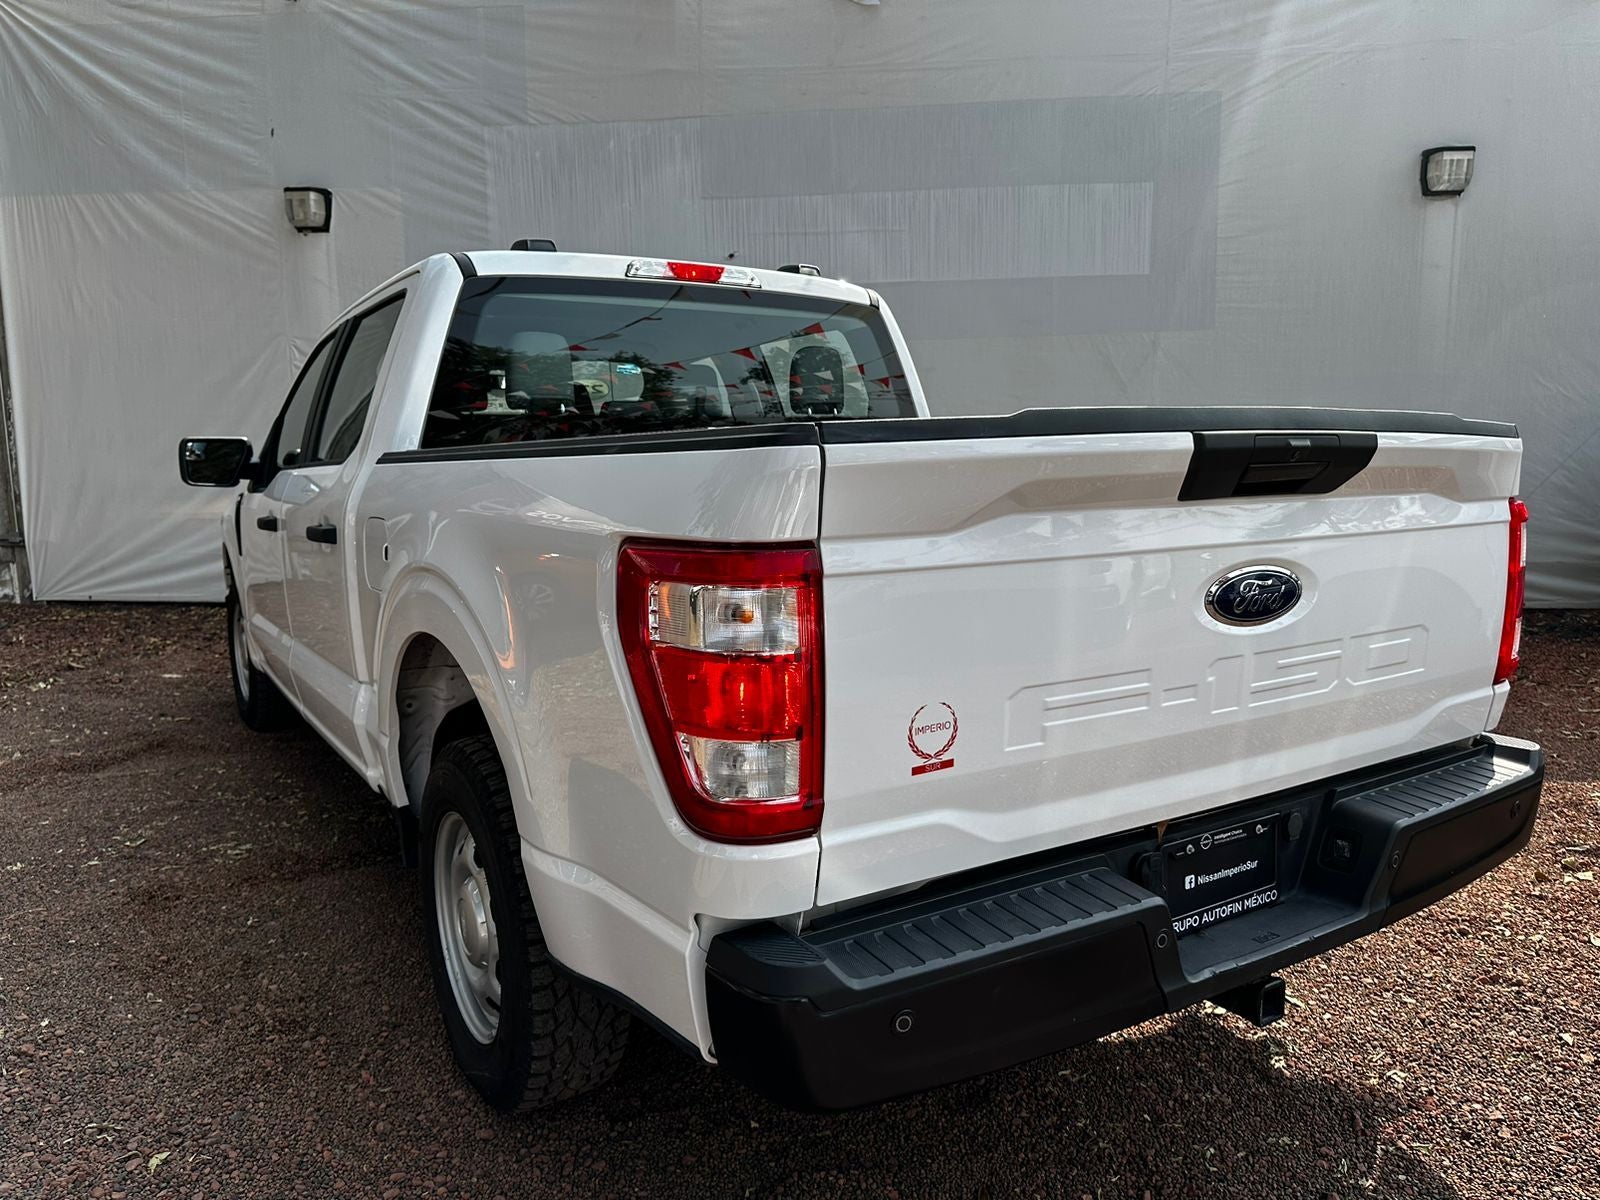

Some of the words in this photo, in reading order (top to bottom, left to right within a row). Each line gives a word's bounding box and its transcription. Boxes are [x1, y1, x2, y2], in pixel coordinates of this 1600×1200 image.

[1233, 579, 1286, 613] Ford
[1003, 624, 1430, 752] F-150
[914, 721, 951, 736] IMPERIO
[925, 762, 941, 772] SUR
[1197, 860, 1258, 885] NissanImperioSur
[1172, 915, 1200, 933] RUPO
[1201, 901, 1243, 924] AUTOFIN
[1244, 889, 1278, 910] MÉXICO
